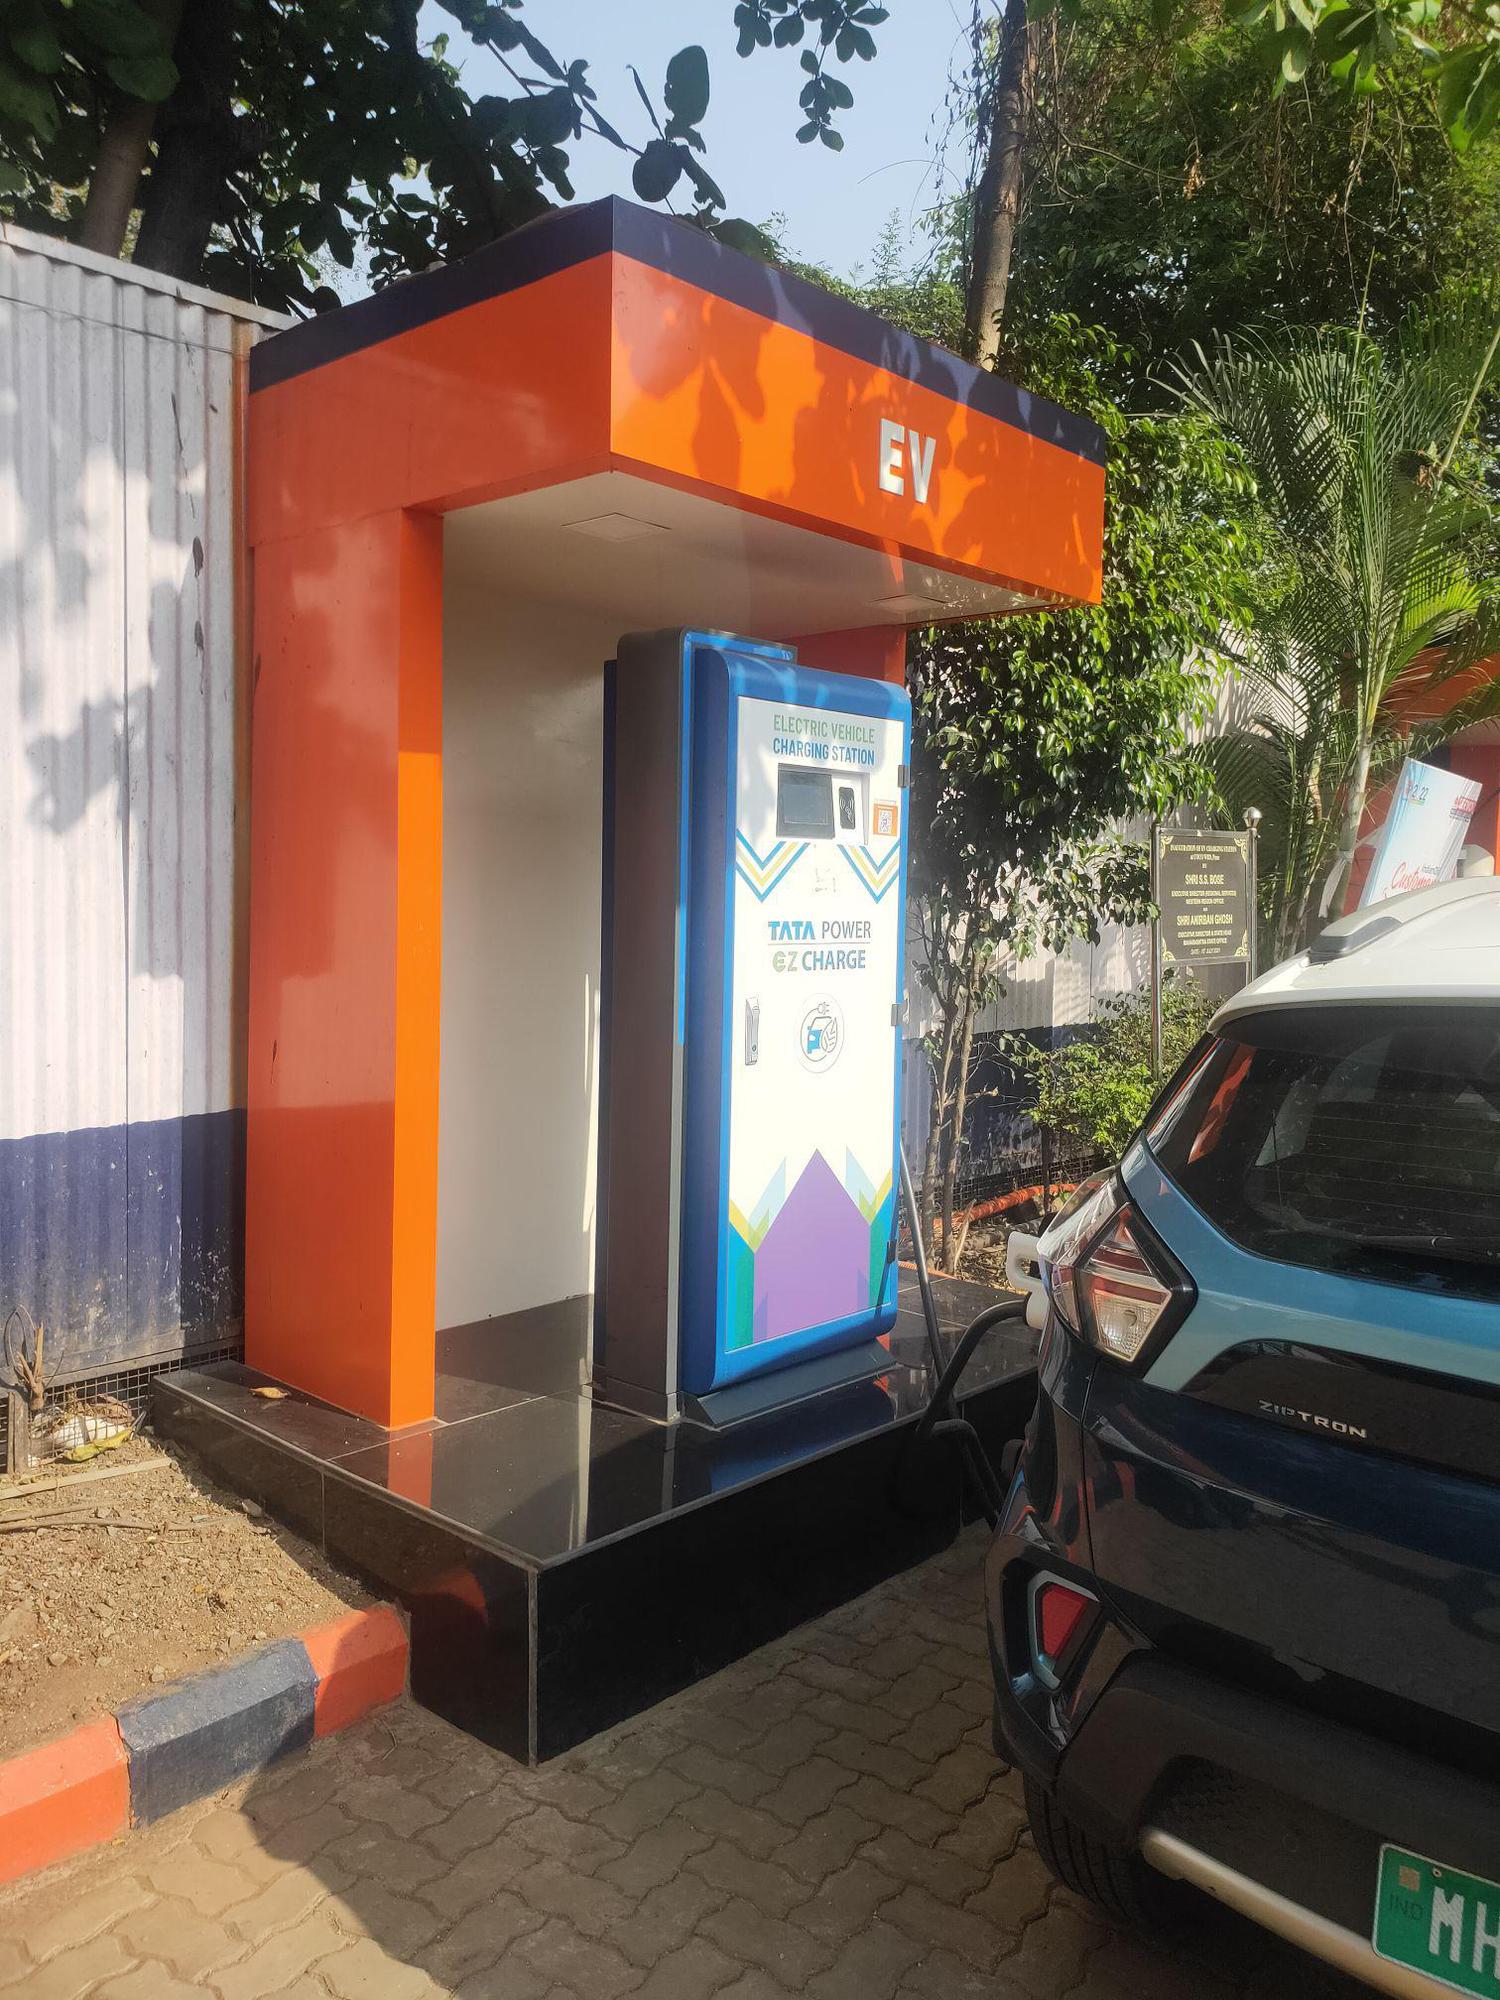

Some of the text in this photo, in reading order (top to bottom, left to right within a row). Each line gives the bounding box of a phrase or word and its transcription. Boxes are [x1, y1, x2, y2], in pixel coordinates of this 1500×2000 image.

[879, 417, 937, 504] EV
[773, 714, 875, 744] ELECTRIC VEHICLE
[773, 737, 875, 766] CHARGING STATION
[1185, 874, 1198, 885] SHRI
[1210, 874, 1224, 885] BOSE
[768, 920, 871, 941] TATA POWER
[1176, 914, 1233, 926] SHRI ANIRBAN GHOSH
[802, 949, 866, 971] CHARGE
[1258, 1399, 1367, 1438] ZIPTRON
